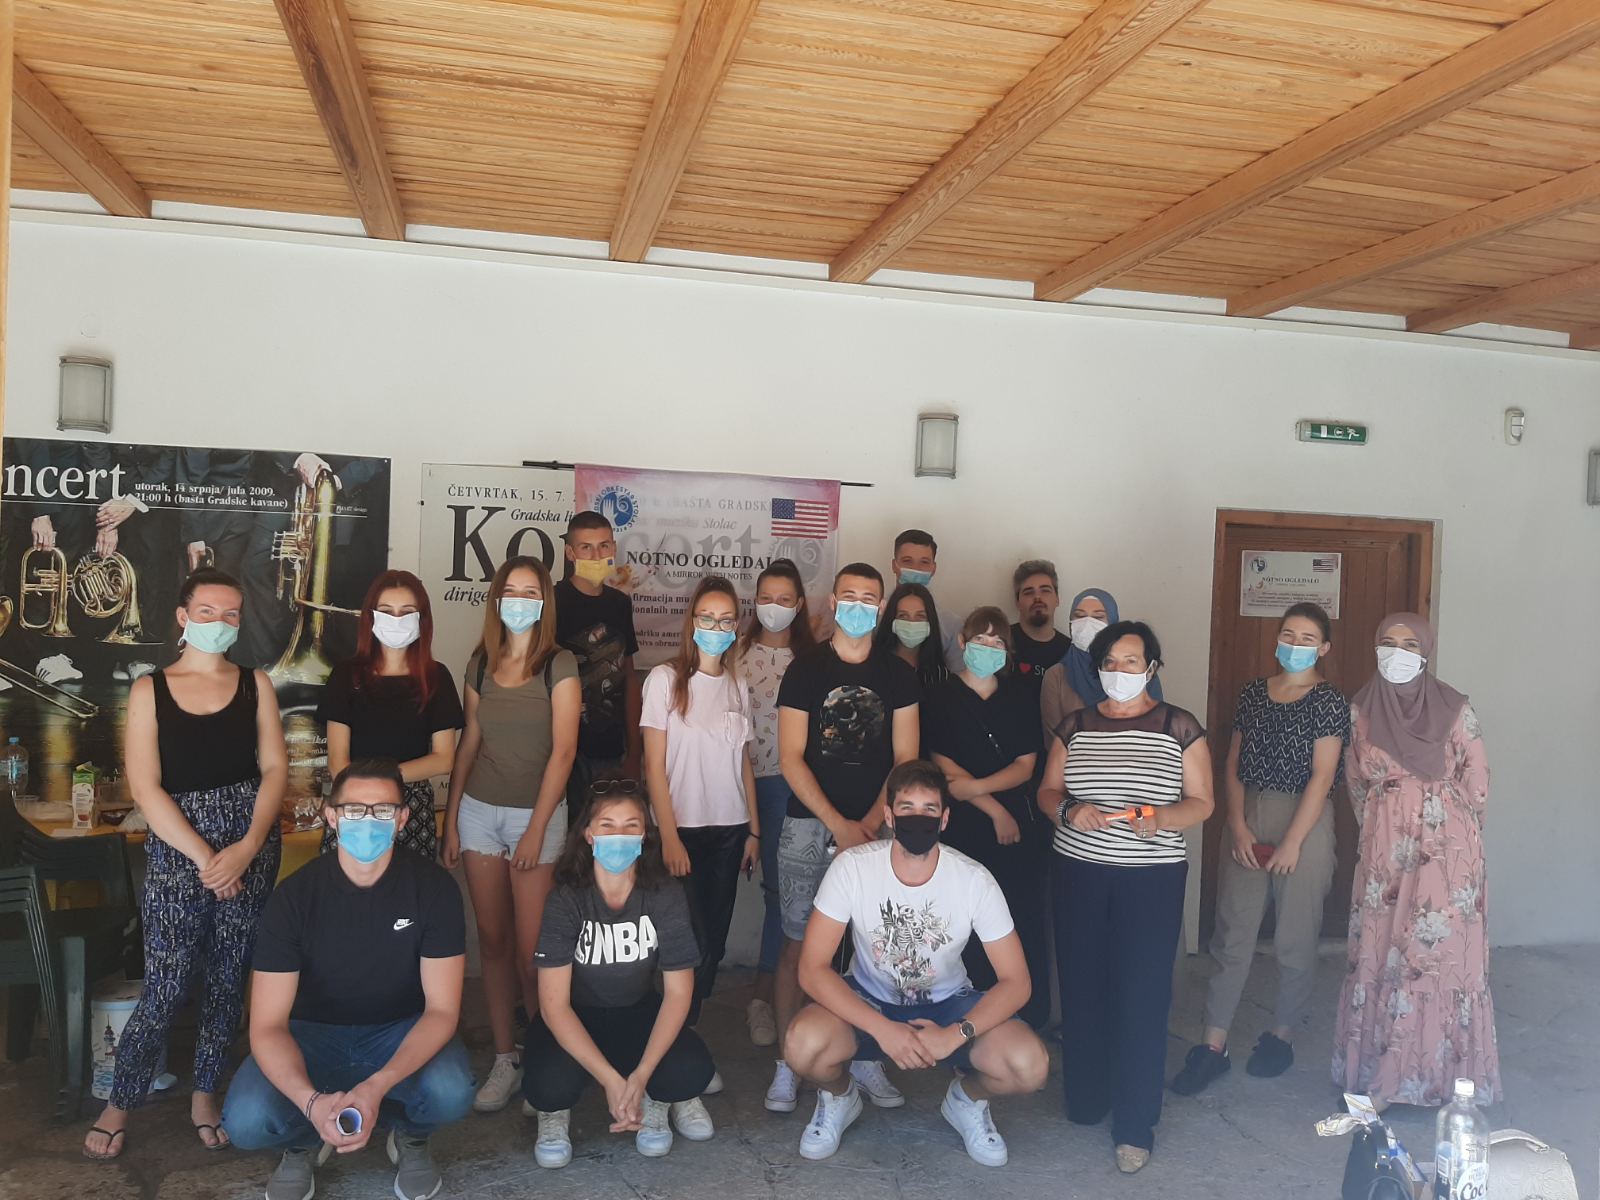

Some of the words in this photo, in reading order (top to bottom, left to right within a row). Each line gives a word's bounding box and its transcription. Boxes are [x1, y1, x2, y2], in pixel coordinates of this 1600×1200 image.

[135, 482, 171, 493] utorak,
[189, 484, 225, 496] srpnja/
[227, 484, 246, 496] jula
[249, 486, 276, 497] 2009.
[448, 483, 523, 503] ČETVRTAK,
[531, 489, 548, 501] 15.
[555, 491, 565, 502] 7.
[164, 493, 171, 502] h
[207, 496, 248, 506] Gradske
[250, 497, 289, 509] kavane)
[510, 508, 561, 522] Gradska
[703, 518, 737, 530] Stolac
[626, 551, 689, 567] NOTNO
[672, 571, 702, 579] MIRROR
[727, 572, 753, 581] NOTES
[591, 915, 658, 965] NBA
